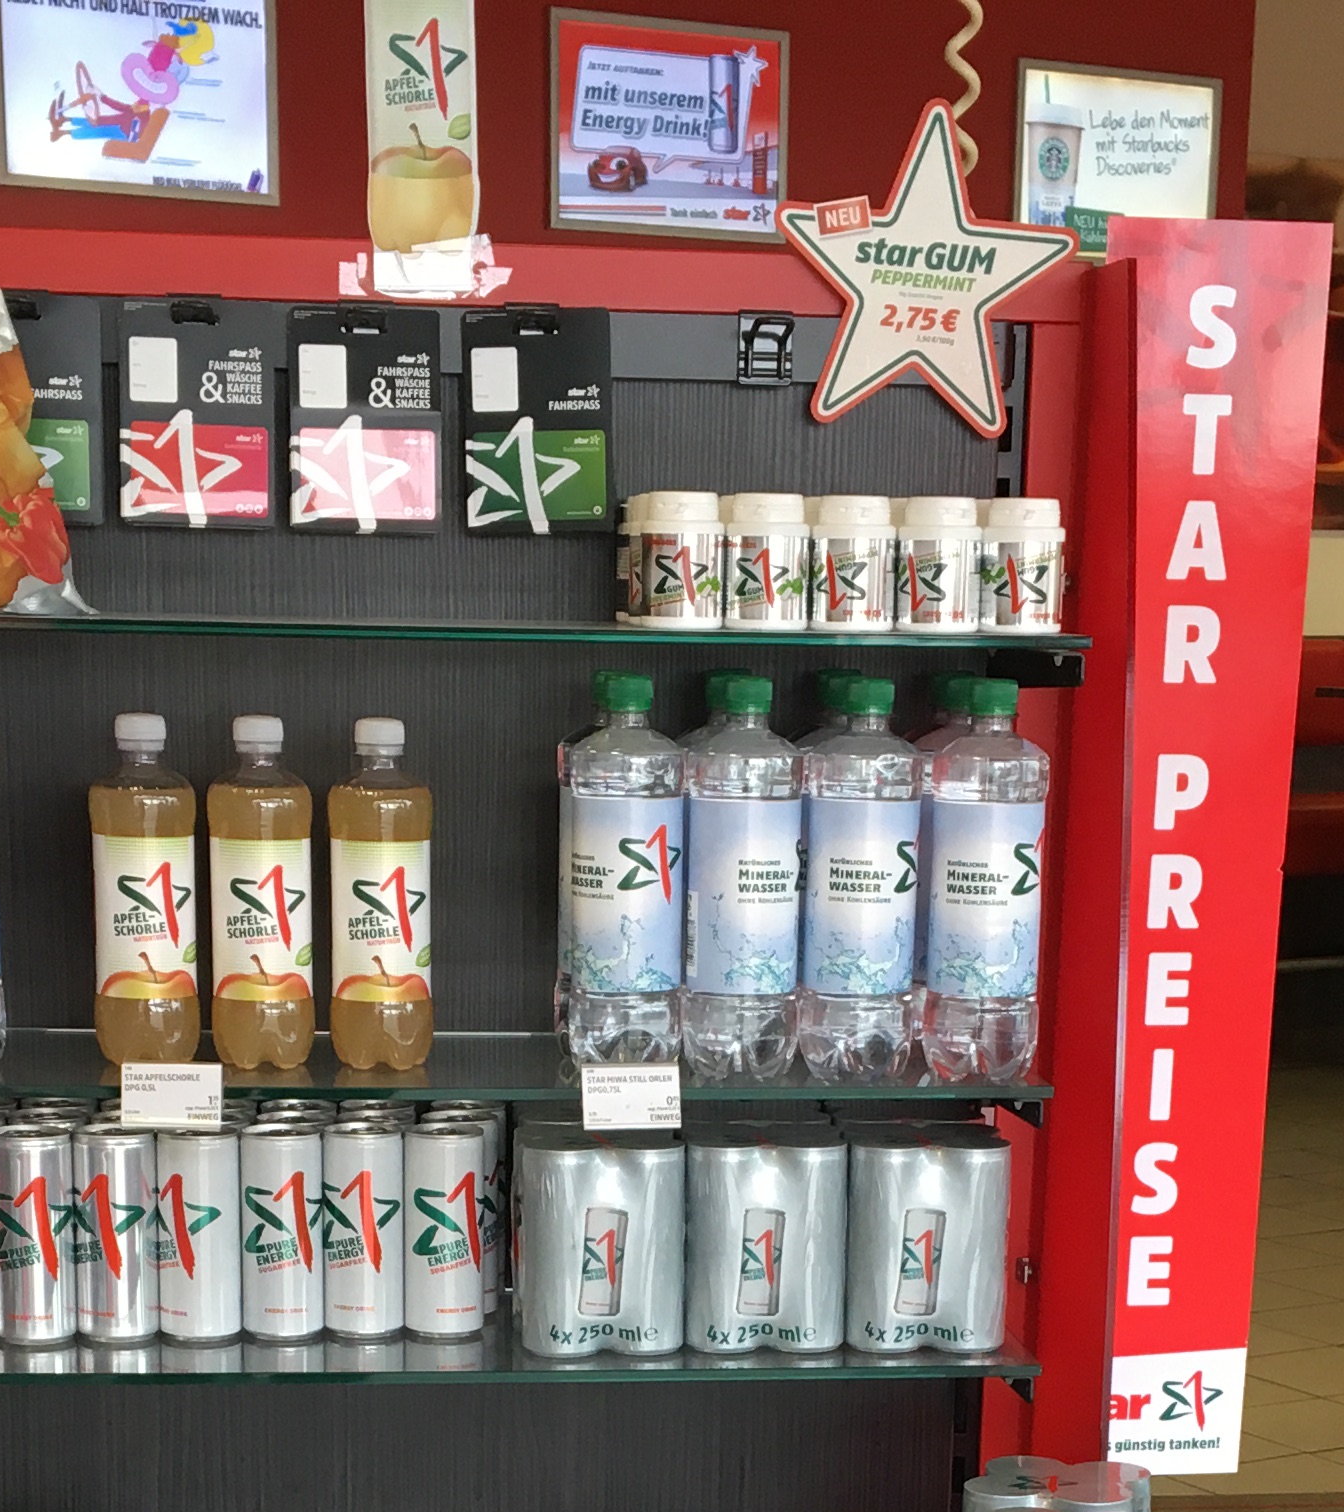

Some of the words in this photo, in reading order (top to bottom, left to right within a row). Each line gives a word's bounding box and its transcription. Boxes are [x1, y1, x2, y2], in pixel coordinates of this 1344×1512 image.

[154, 2, 220, 24] TROTZDEM
[223, 10, 263, 29] WACH.
[384, 77, 424, 93] APFEL-
[385, 89, 435, 104] SCHORLE
[583, 81, 619, 102] mit
[624, 88, 704, 110] unserem
[580, 109, 648, 136] Energy
[652, 115, 709, 140] Drink!
[1089, 109, 1126, 131] Lebe
[1131, 109, 1155, 131] den
[1160, 109, 1210, 131] Moment
[1095, 132, 1117, 153] mit
[1122, 132, 1191, 154] Starbucks
[824, 204, 862, 229] NEU
[1073, 214, 1095, 229] NEU
[855, 237, 997, 275] starGUM
[870, 268, 977, 293] PEPPERMINT
[208, 360, 262, 373] FAHRSPASS
[377, 366, 431, 378] FAHRSPASS
[199, 371, 224, 404] &
[226, 383, 262, 394] KAFFEE
[368, 378, 394, 409] &
[395, 388, 431, 399] KAFFEE
[567, 386, 588, 398] star
[226, 394, 263, 405] SNACKS
[395, 399, 431, 409] SNACKS
[548, 400, 602, 412] FAHRSPASS
[1163, 284, 1239, 685] STAR
[738, 868, 794, 882] MINERAL-
[829, 867, 893, 881] MINERAL-
[947, 869, 1009, 883] MINERAL-
[738, 881, 787, 895] WASSER
[829, 880, 881, 893] WASSER
[946, 882, 997, 896] WASSER
[113, 911, 155, 924] APFEL-
[226, 914, 266, 926] APFEL-
[348, 916, 389, 928] APFEL-
[114, 921, 167, 936] SCHORLE
[227, 924, 278, 940] SCHORLE
[348, 926, 400, 940] SCHORLE
[1126, 752, 1212, 1307] PREISE
[587, 1076, 605, 1084] STAR
[650, 1113, 681, 1121] EINWEG
[8, 1243, 40, 1259] PURE
[266, 1237, 297, 1253] PURE
[335, 1236, 364, 1251] PURE
[438, 1238, 469, 1254] PURE
[256, 1247, 299, 1267] ENERGY
[328, 1247, 366, 1262] ENERGY
[428, 1247, 470, 1267] ENERGY
[0, 1253, 42, 1273] ENERGY
[1108, 1394, 1152, 1421] ar
[1115, 1438, 1166, 1453] günstig
[1169, 1436, 1221, 1451] tanken!
